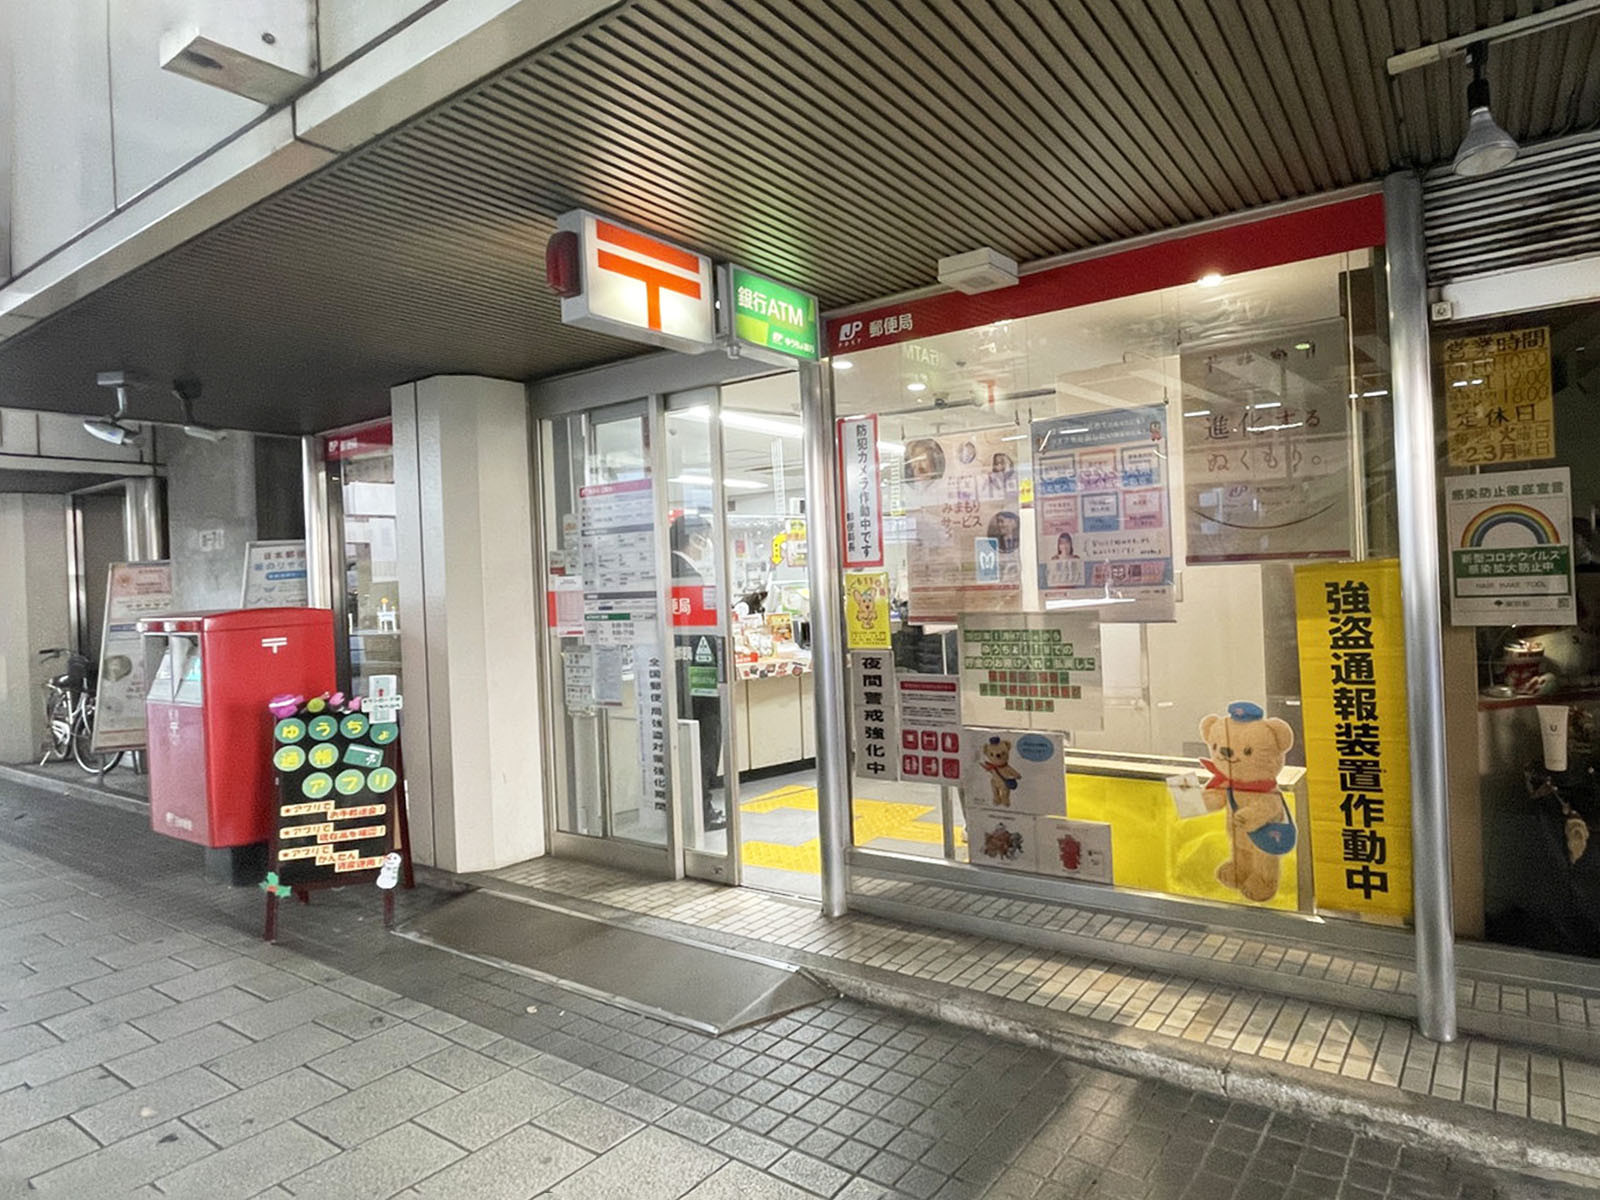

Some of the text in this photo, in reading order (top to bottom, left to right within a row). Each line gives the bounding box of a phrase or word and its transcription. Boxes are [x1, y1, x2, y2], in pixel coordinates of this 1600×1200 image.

[737, 286, 804, 327] 銀行ATM
[868, 313, 914, 338] 郵便局
[1204, 409, 1321, 440] 進化する
[1454, 403, 1536, 428] 定休日
[856, 423, 872, 558] 防犯カメラ作動中です
[1451, 481, 1563, 500] 感染防止徹底宣言
[1461, 549, 1561, 564] 新型コロナウイルス
[1468, 563, 1555, 576] 感染拡大防止中
[862, 656, 886, 775] 夜間警戒強化中
[281, 721, 389, 741] ゆうちょ
[1325, 579, 1389, 900] 強盗通報装置作動中
